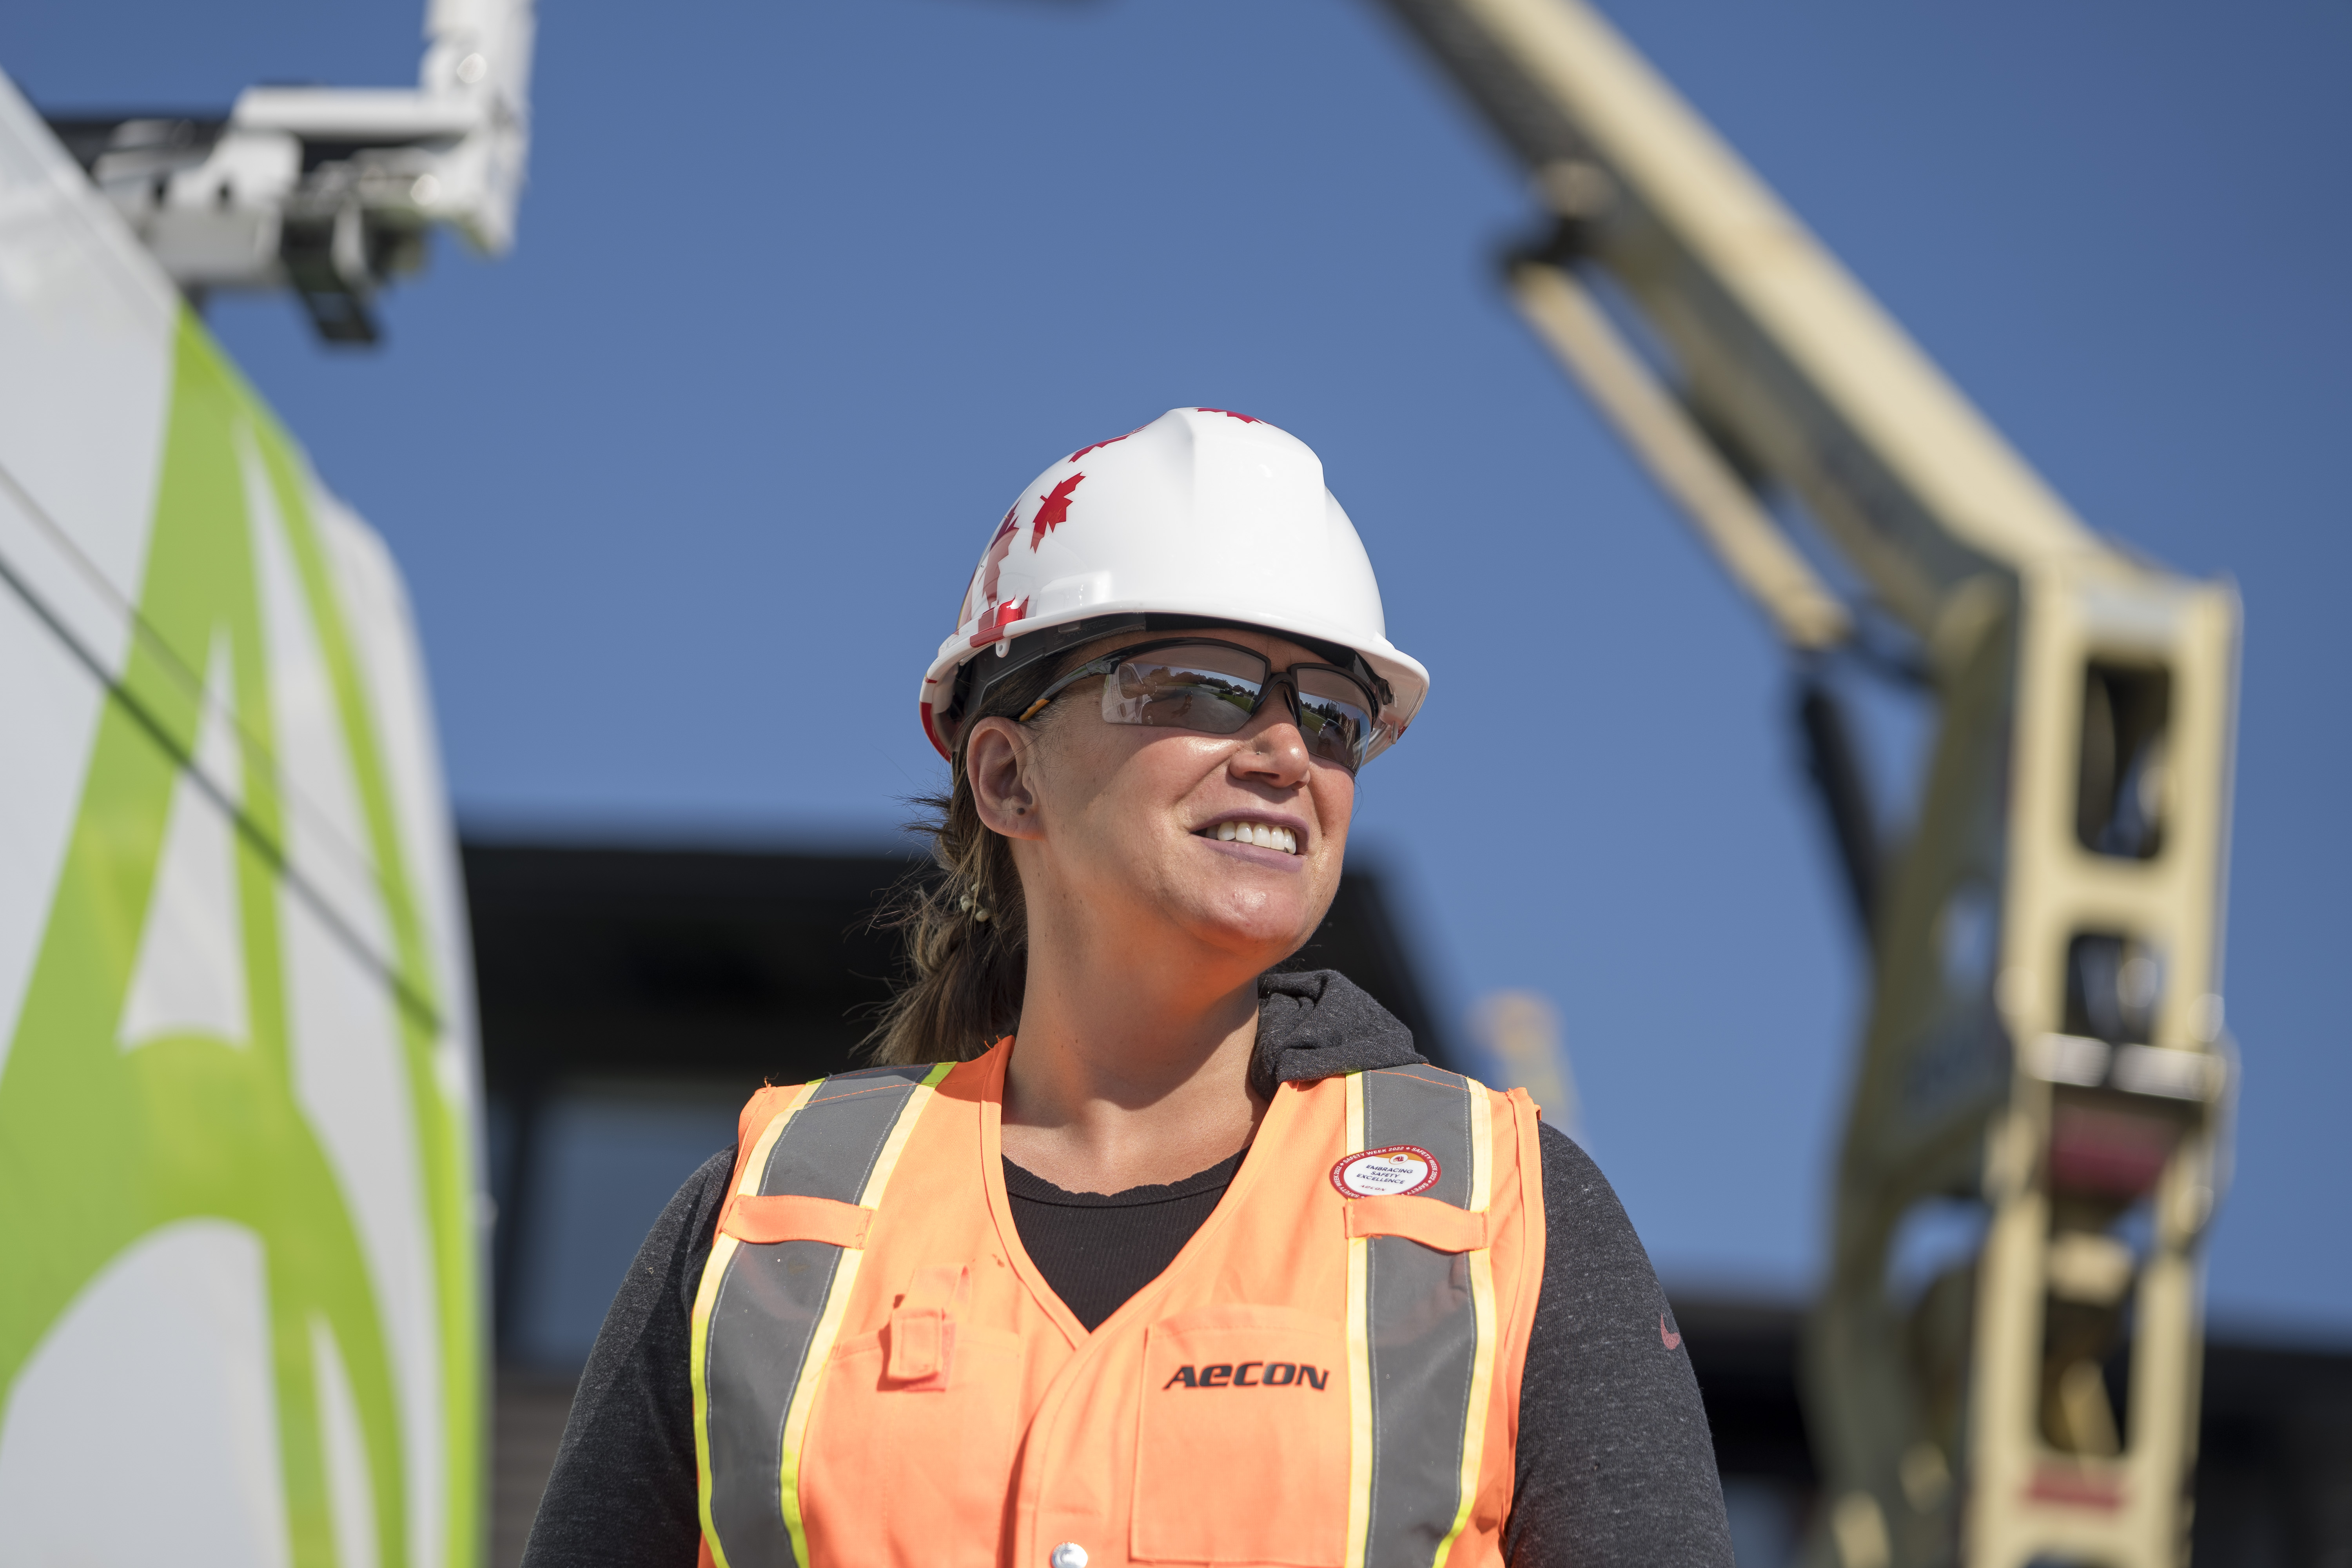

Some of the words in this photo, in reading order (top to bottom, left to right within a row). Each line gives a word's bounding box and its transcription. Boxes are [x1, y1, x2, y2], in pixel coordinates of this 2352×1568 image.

[1343, 1152, 1365, 1163] SAFETY
[1411, 1147, 1432, 1159] SAFETY
[1334, 1166, 1342, 1175] 2022
[1366, 1165, 1413, 1174] EMBRACING
[1429, 1159, 1438, 1171] WEEK
[1333, 1175, 1342, 1187] WEEK
[1356, 1173, 1405, 1184] EXCELLENCE
[1429, 1171, 1437, 1180] 2022
[1339, 1187, 1359, 1198] SAFETY
[1407, 1182, 1429, 1195] SAFETY
